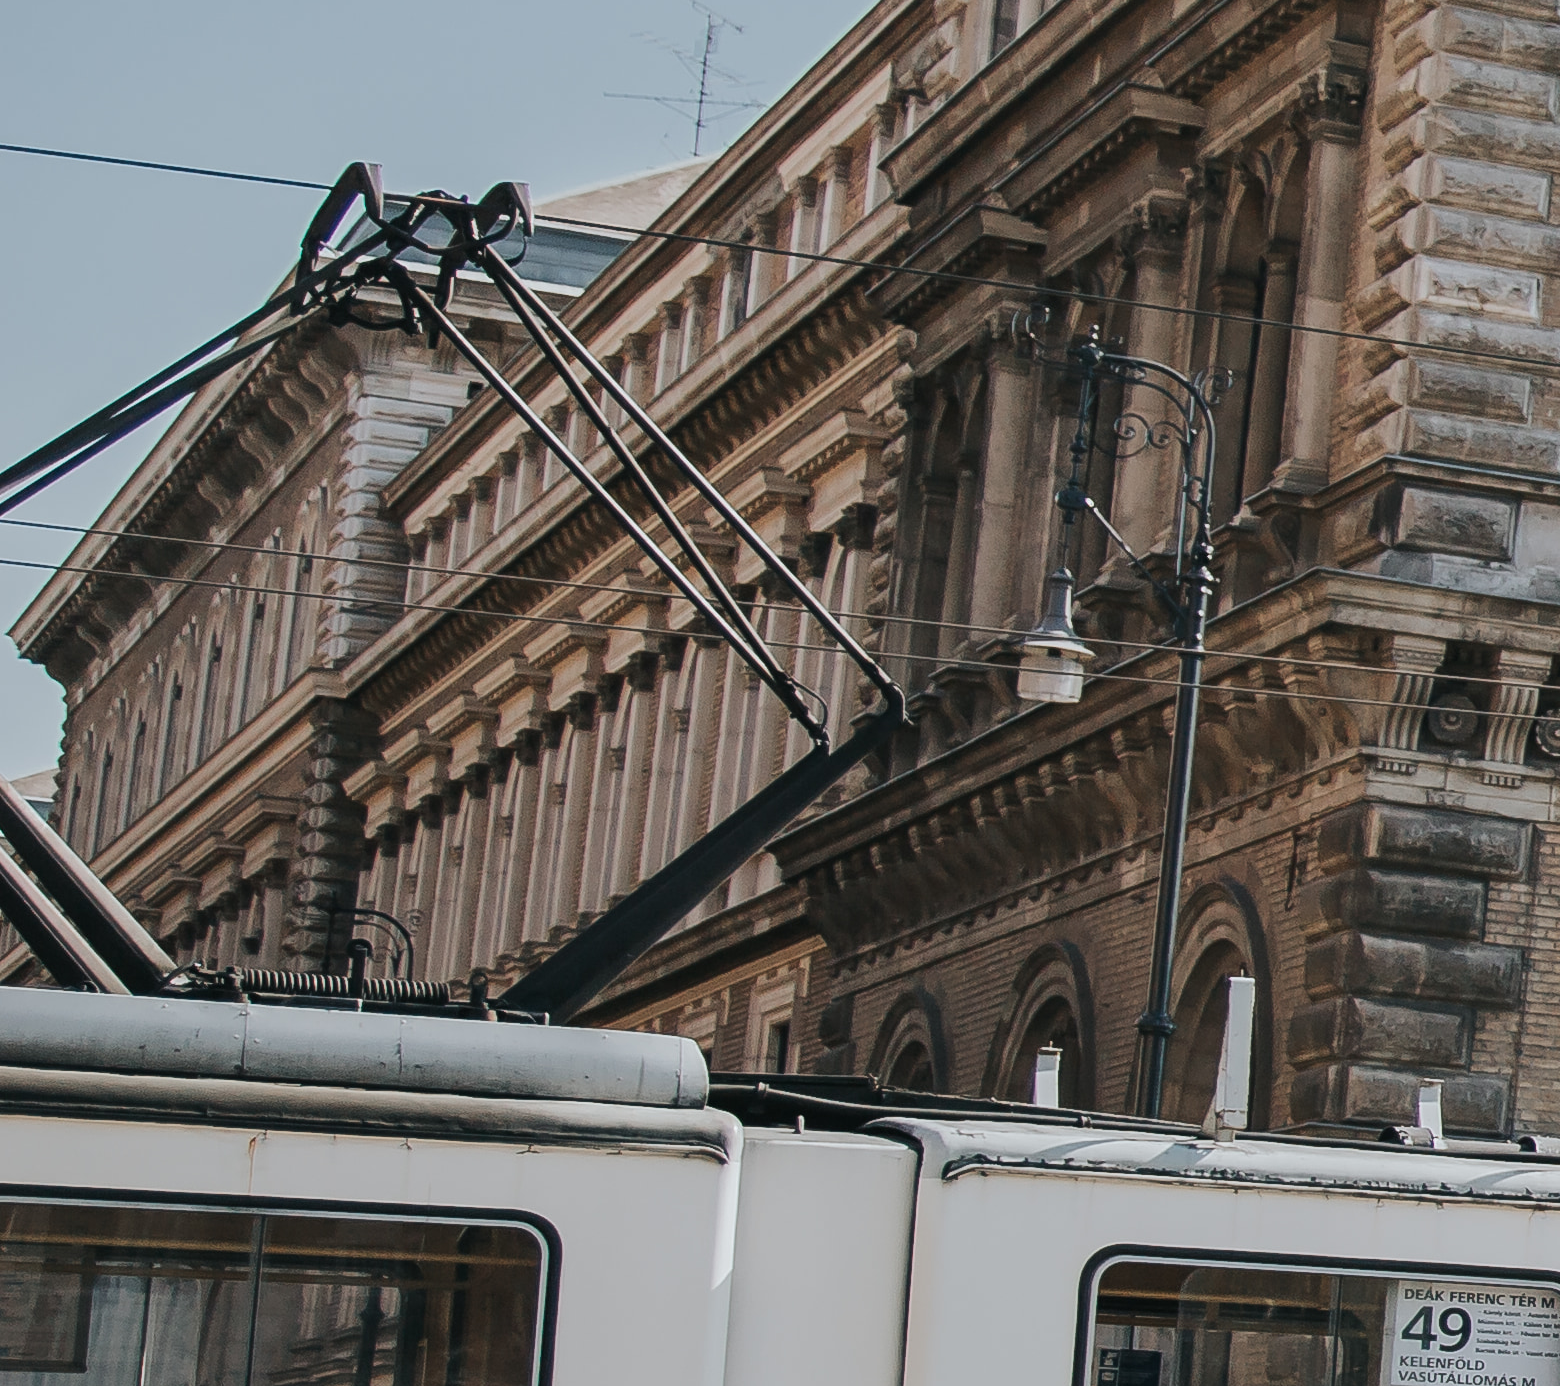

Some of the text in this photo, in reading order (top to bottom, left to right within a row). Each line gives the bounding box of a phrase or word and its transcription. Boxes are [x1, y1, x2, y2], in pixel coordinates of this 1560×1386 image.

[1404, 1287, 1555, 1309] DEÁK FERENC TÉR M
[1401, 1305, 1472, 1353] 49
[1399, 1356, 1485, 1371] KELENFÖLD
